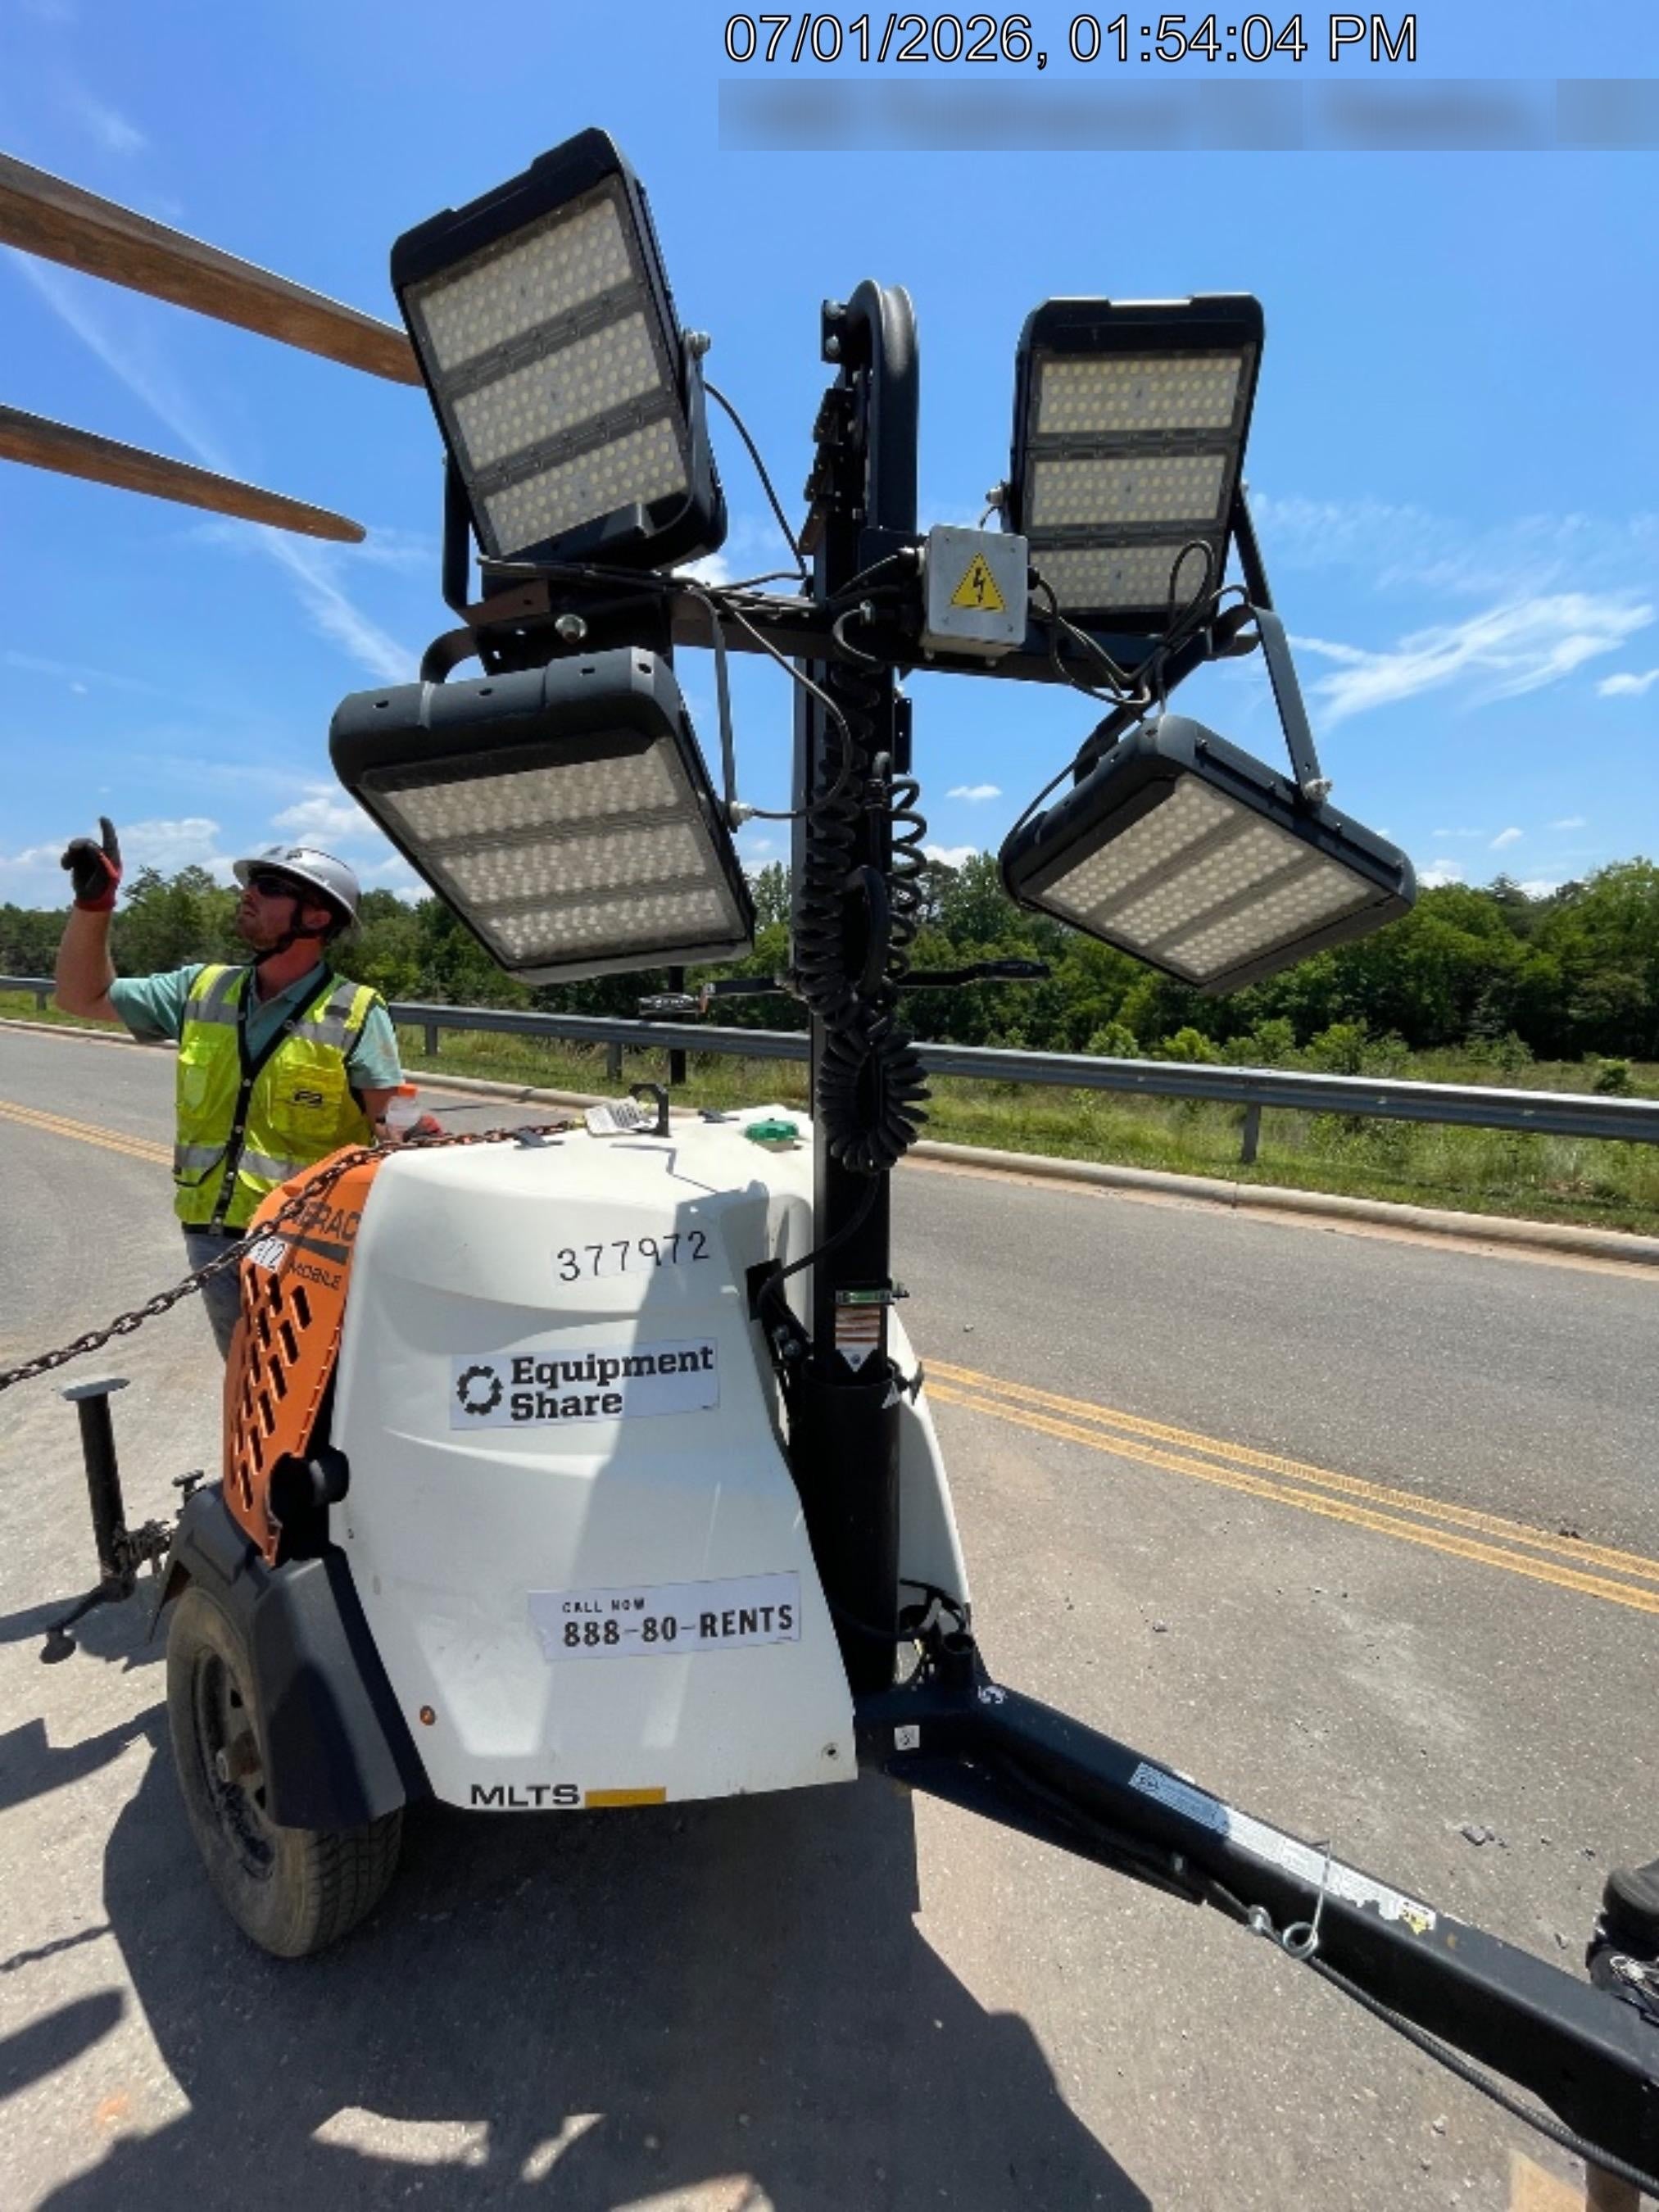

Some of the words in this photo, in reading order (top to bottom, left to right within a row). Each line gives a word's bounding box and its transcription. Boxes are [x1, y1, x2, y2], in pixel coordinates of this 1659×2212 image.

[556, 1231, 710, 1281] 377972
[288, 1262, 342, 1290] MOBILE
[510, 1346, 714, 1389] Equipment
[510, 1391, 623, 1421] Share
[561, 1600, 603, 1613] CALL
[610, 1597, 646, 1611] NOW
[563, 1604, 794, 1648] 888-80-RENTS
[470, 1784, 580, 1806] MLTS
